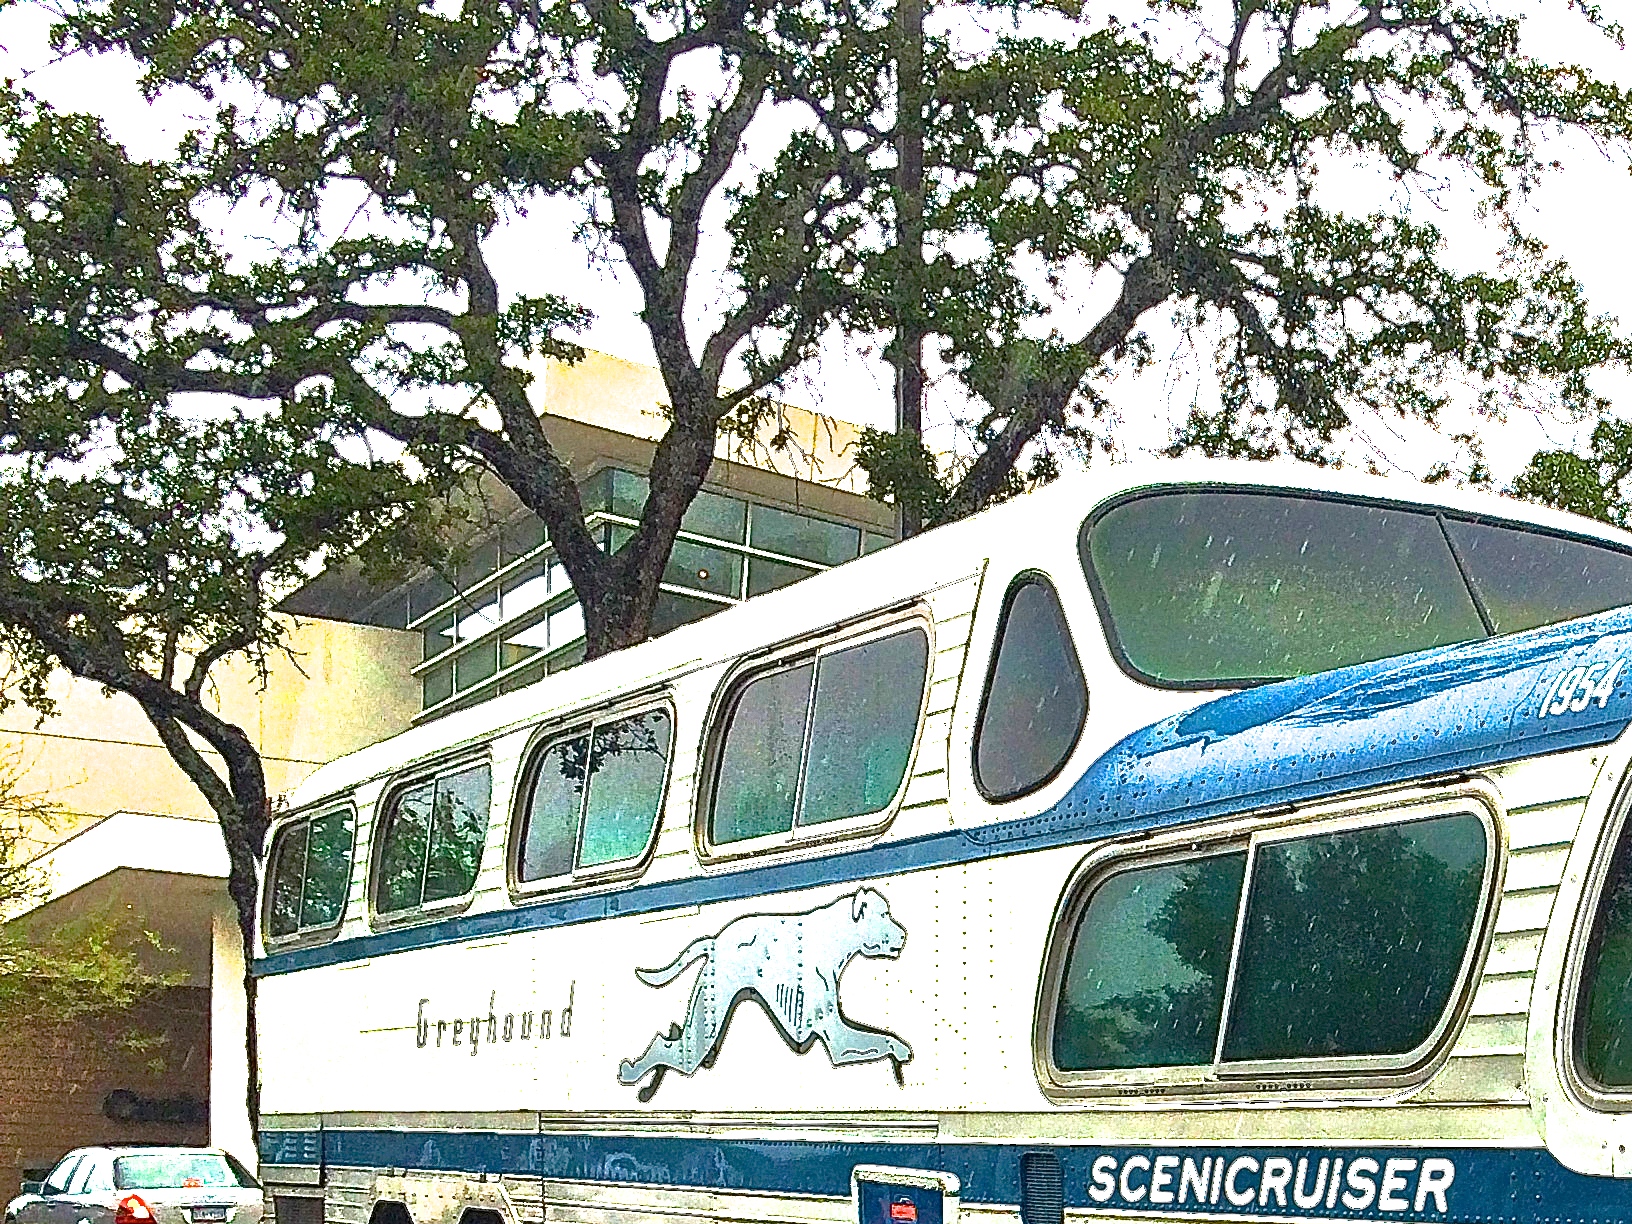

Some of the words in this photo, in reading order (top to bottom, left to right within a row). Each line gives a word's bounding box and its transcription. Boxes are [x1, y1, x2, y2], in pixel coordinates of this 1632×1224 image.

[1537, 657, 1627, 719] 1954
[416, 980, 576, 1057] Greyhound
[1086, 1154, 1456, 1213] SCENICRUISER
